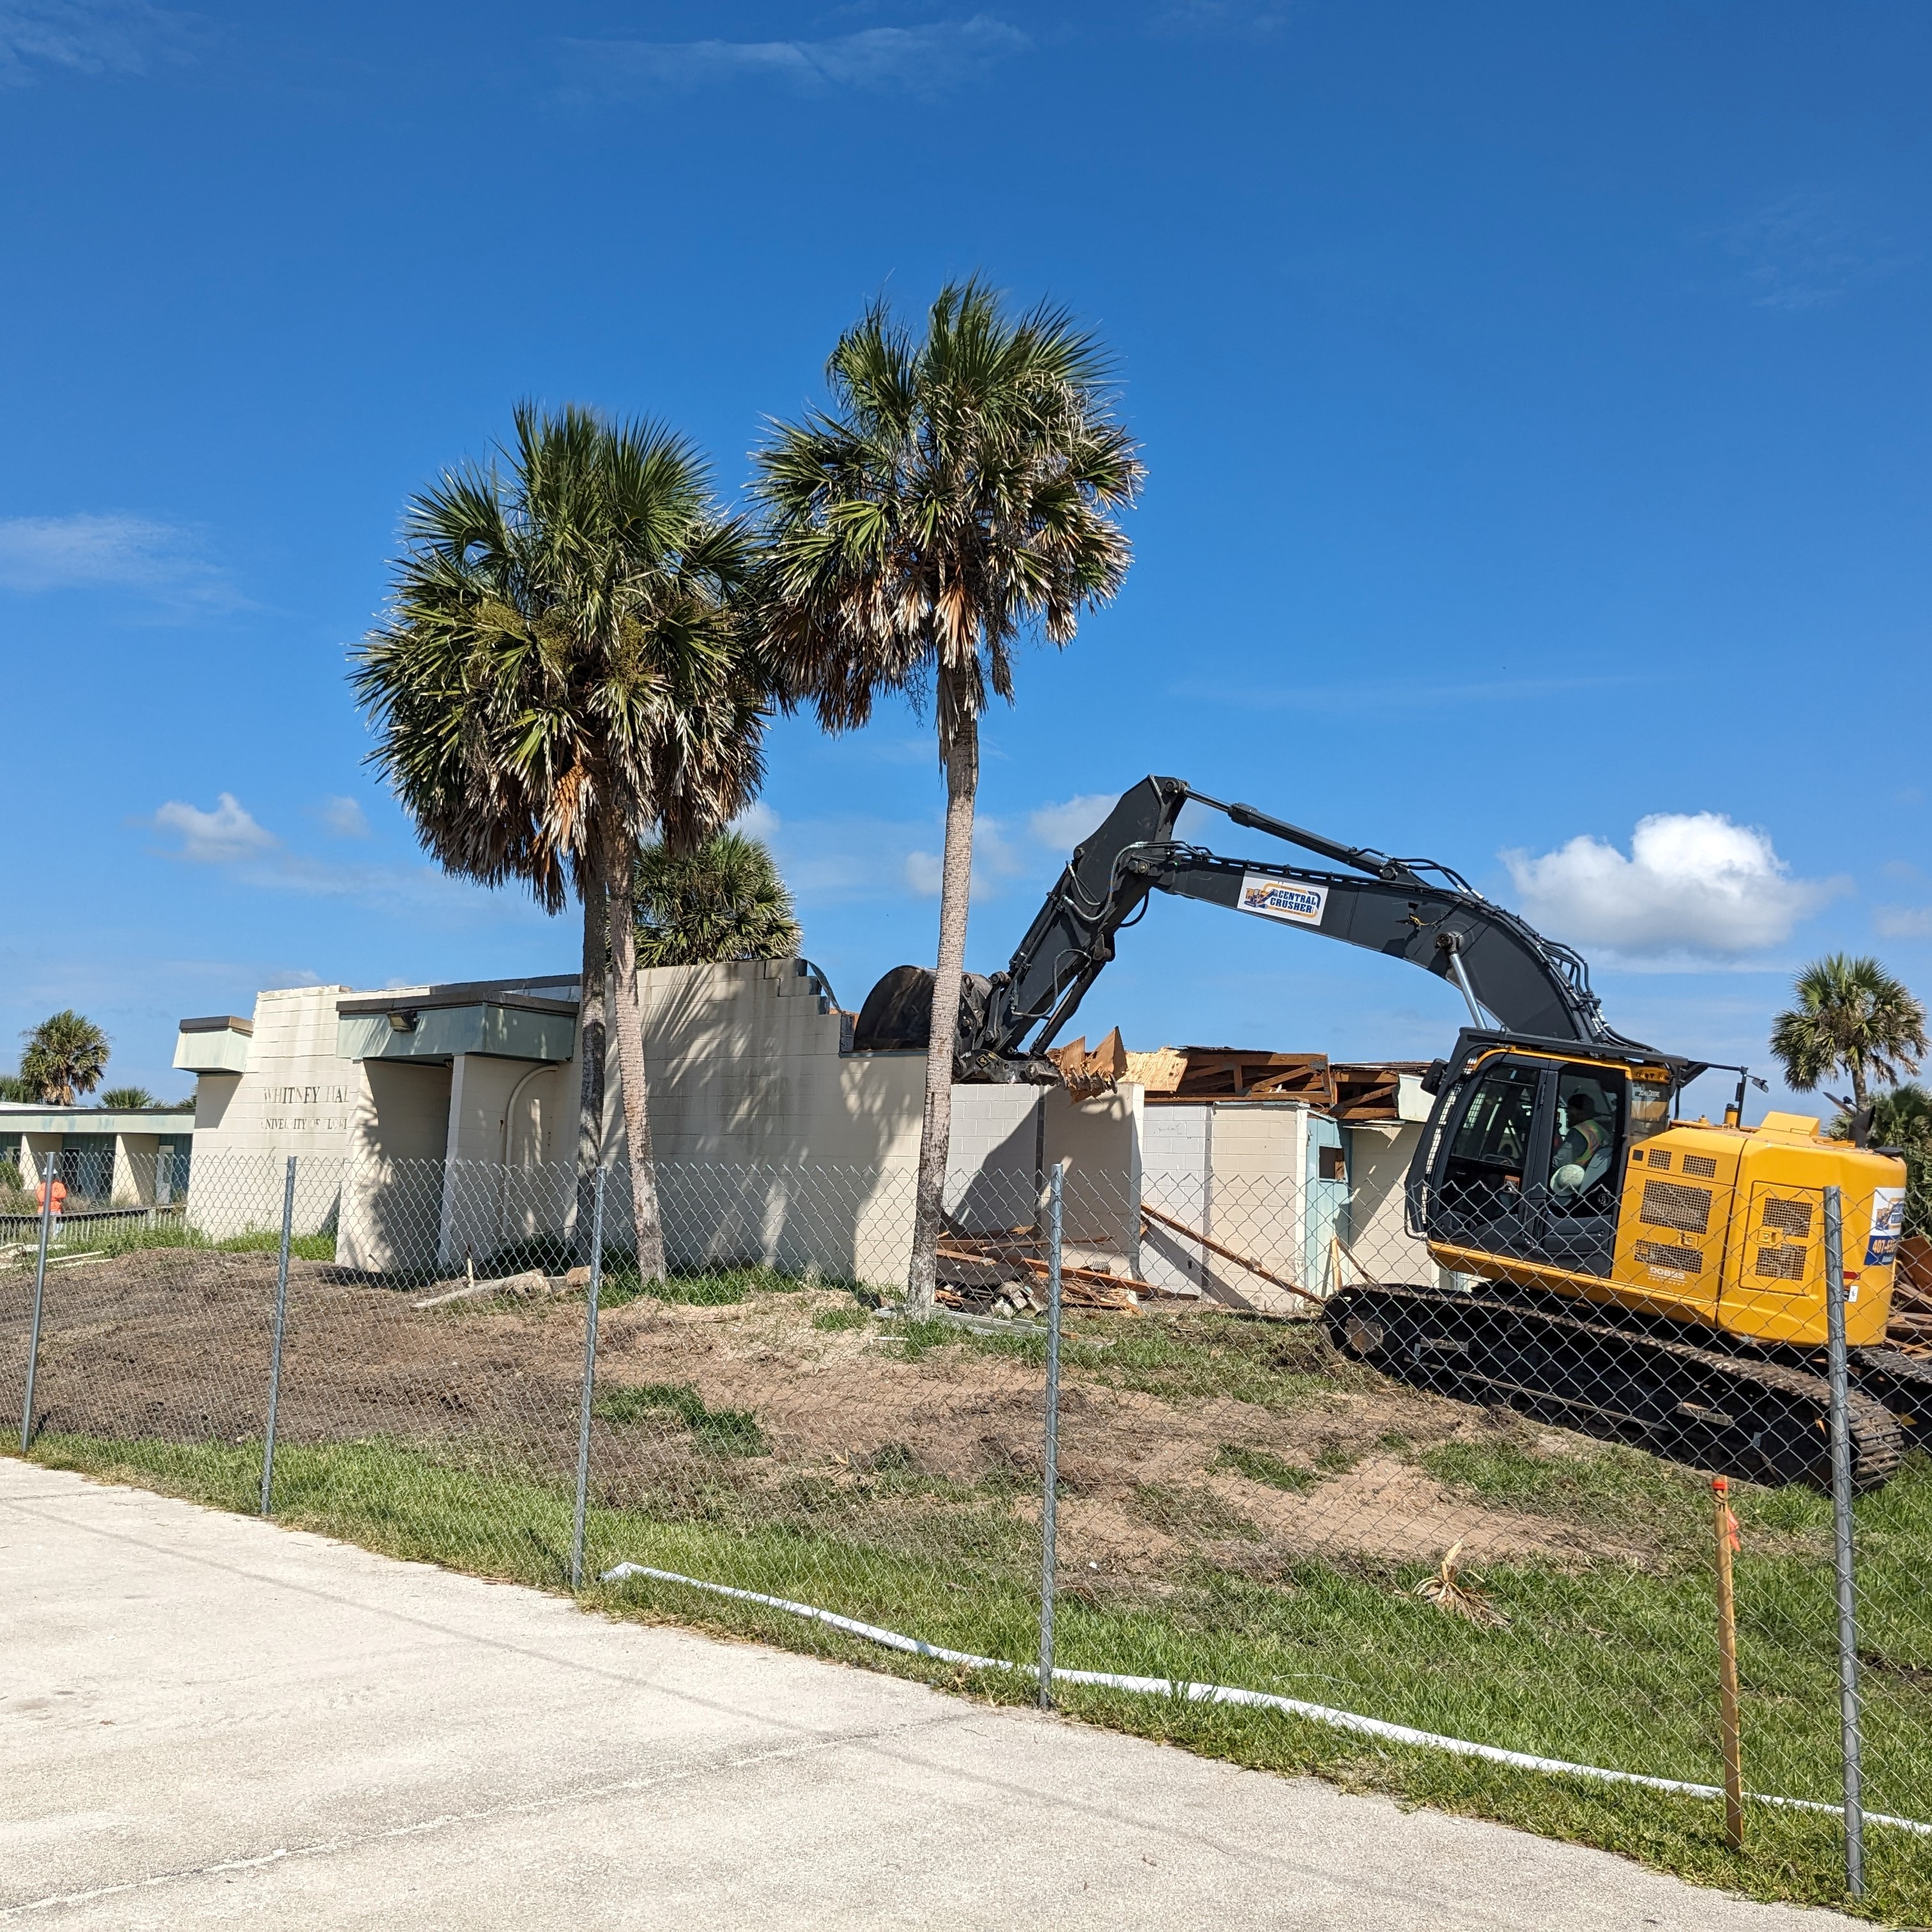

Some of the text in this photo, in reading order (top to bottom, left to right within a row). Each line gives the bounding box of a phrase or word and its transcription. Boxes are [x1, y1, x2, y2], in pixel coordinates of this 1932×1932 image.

[1278, 890, 1317, 905] CENTRAL
[1270, 898, 1312, 914] CRUSHER
[264, 1086, 320, 1103] WHITNEY
[1650, 1267, 1685, 1280] DOBBS
